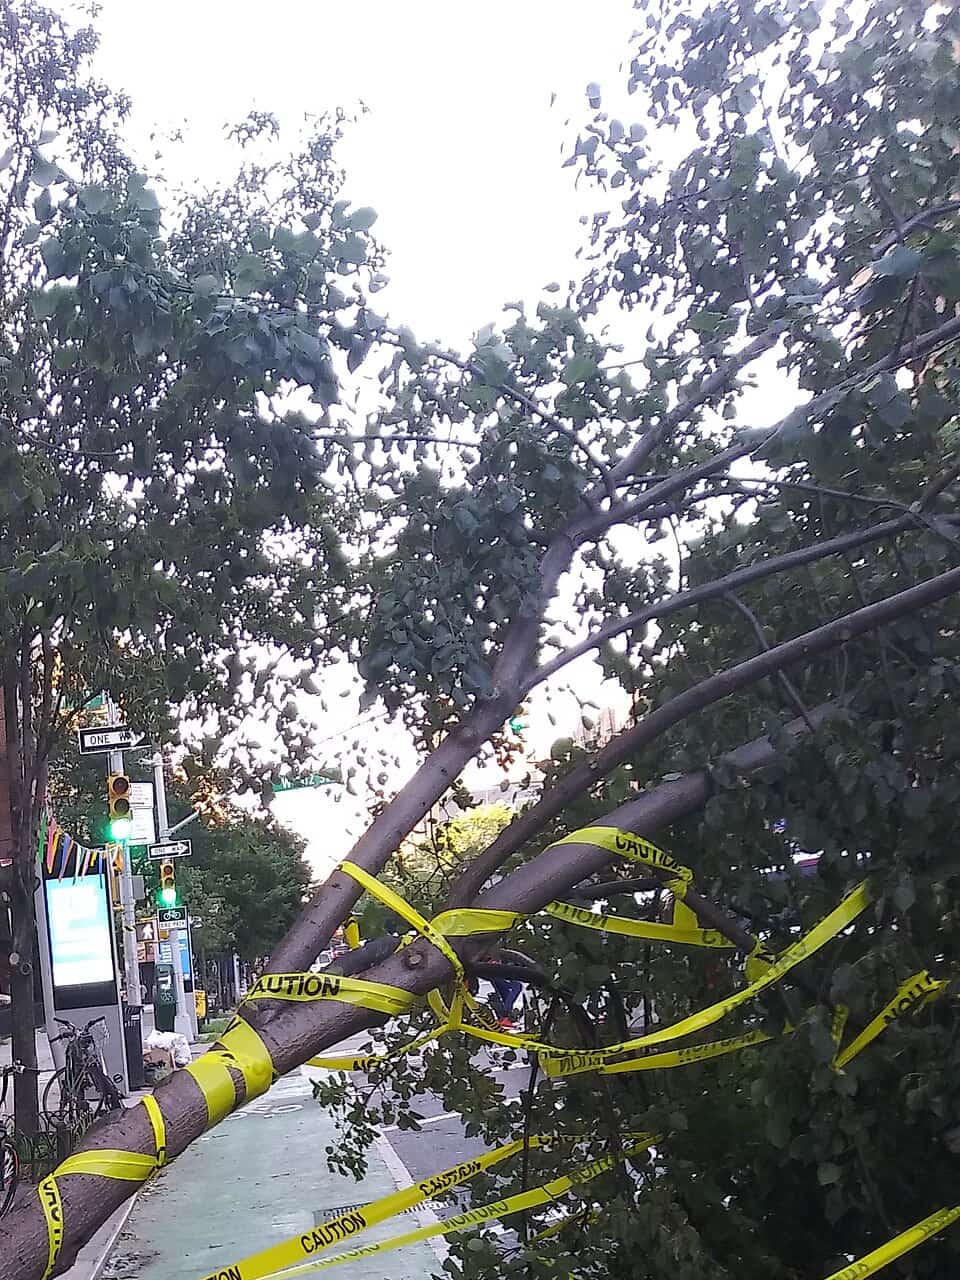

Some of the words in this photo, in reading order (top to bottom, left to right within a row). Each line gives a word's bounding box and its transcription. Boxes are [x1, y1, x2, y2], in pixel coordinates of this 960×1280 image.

[90, 735, 110, 745] ONE
[250, 975, 341, 998] AUTION
[419, 1161, 482, 1196] CAUTION
[301, 1212, 367, 1254] CAUTION
